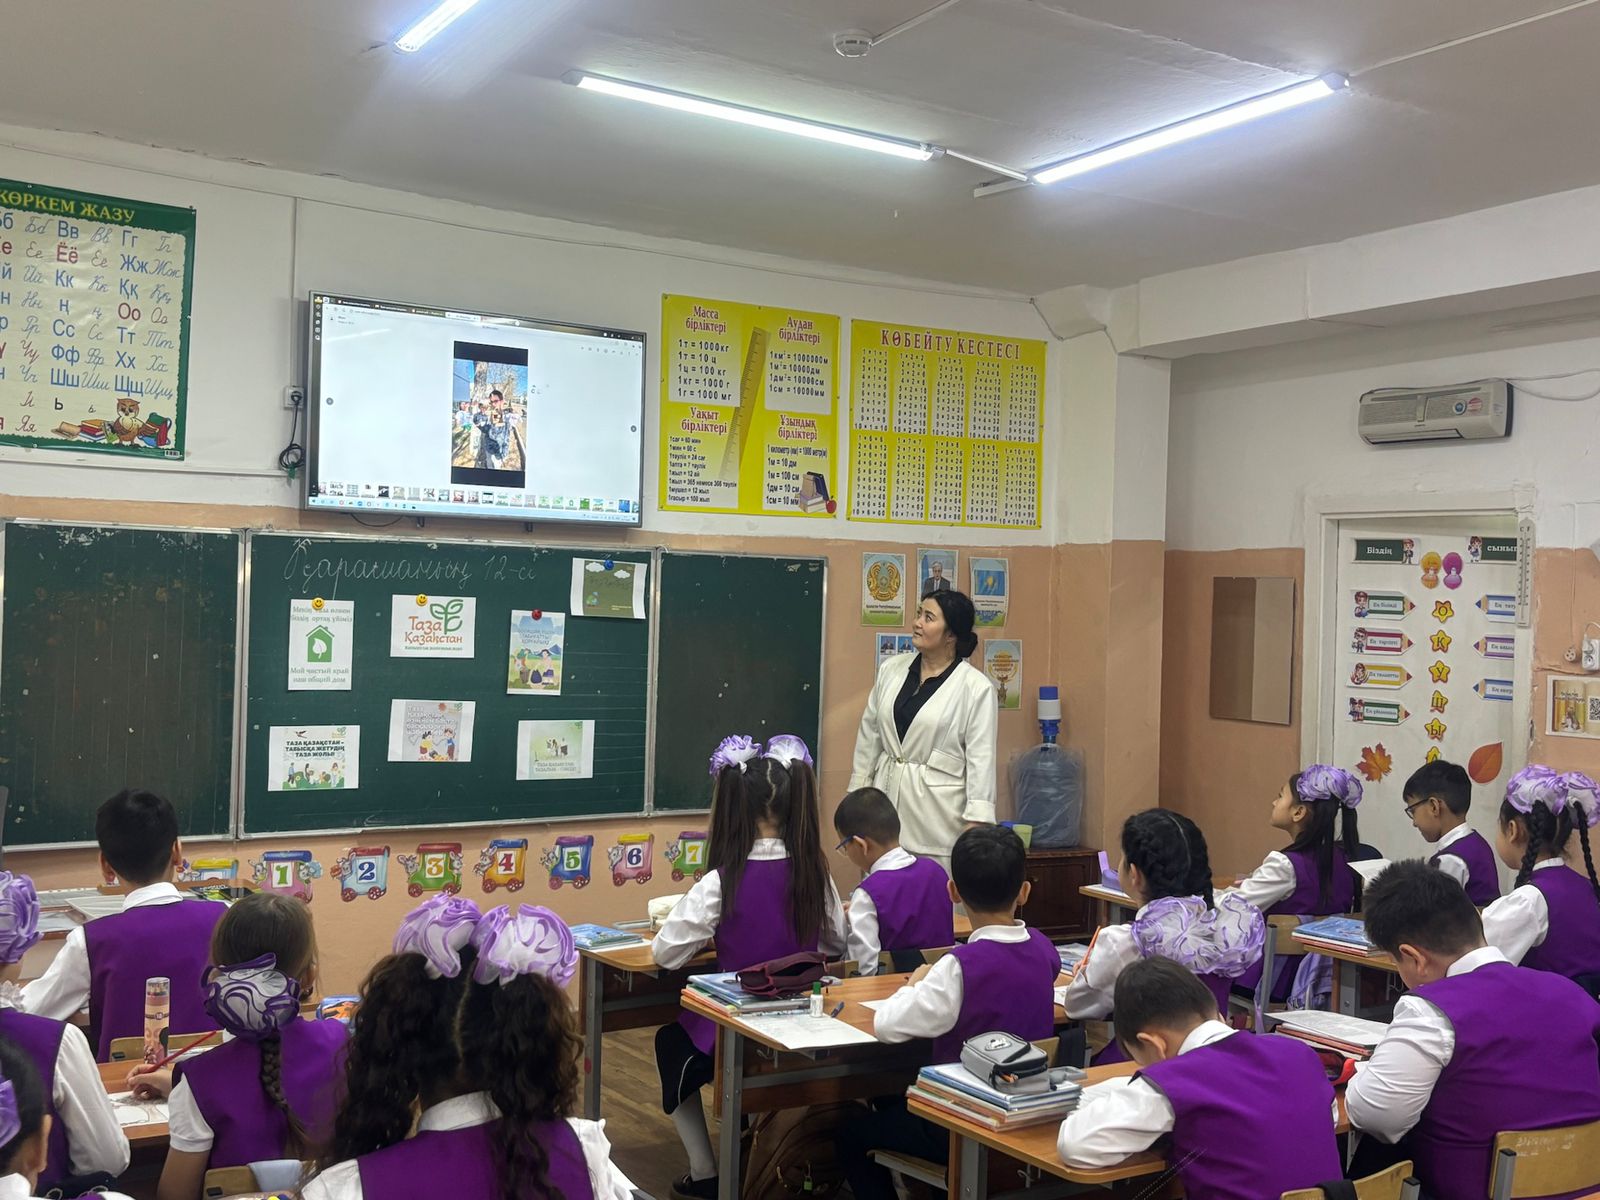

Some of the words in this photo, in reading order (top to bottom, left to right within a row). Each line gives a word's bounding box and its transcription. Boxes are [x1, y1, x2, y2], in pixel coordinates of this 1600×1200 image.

[80, 202, 135, 223] ЖАЗУ
[58, 220, 79, 239] Вв
[122, 230, 138, 248] Гг
[57, 242, 79, 264] Ёё
[120, 254, 149, 275] Жж
[56, 268, 75, 289] Кк
[118, 302, 141, 321] Оо
[693, 305, 719, 319] Масса
[53, 319, 75, 338] Сс
[117, 326, 136, 344] Тт
[685, 317, 726, 335] бірліктері
[787, 316, 813, 331] Аудан
[778, 328, 820, 346] бірліктері
[881, 329, 953, 352] КӨБЕЙТУ
[957, 338, 1020, 360] КЕСТЕСІ
[52, 344, 80, 367] Фф
[115, 350, 136, 369] Хх
[700, 365, 715, 375] 100
[50, 368, 80, 388] Шш
[115, 375, 143, 397] Щщ
[703, 378, 724, 388] 1000
[698, 389, 719, 400] 1000
[690, 406, 719, 421] Уақыт
[780, 414, 817, 431] Ұзындық
[681, 419, 727, 436] бірліктері
[778, 427, 817, 442] бірліктері
[1366, 546, 1393, 555] Біздің
[408, 616, 442, 635] Таза
[498, 853, 514, 872] 4
[566, 850, 581, 869] 5
[627, 847, 642, 865] 6
[687, 845, 702, 862] 7
[275, 865, 289, 885] 1
[358, 861, 376, 880] 2
[427, 857, 444, 876] 3
